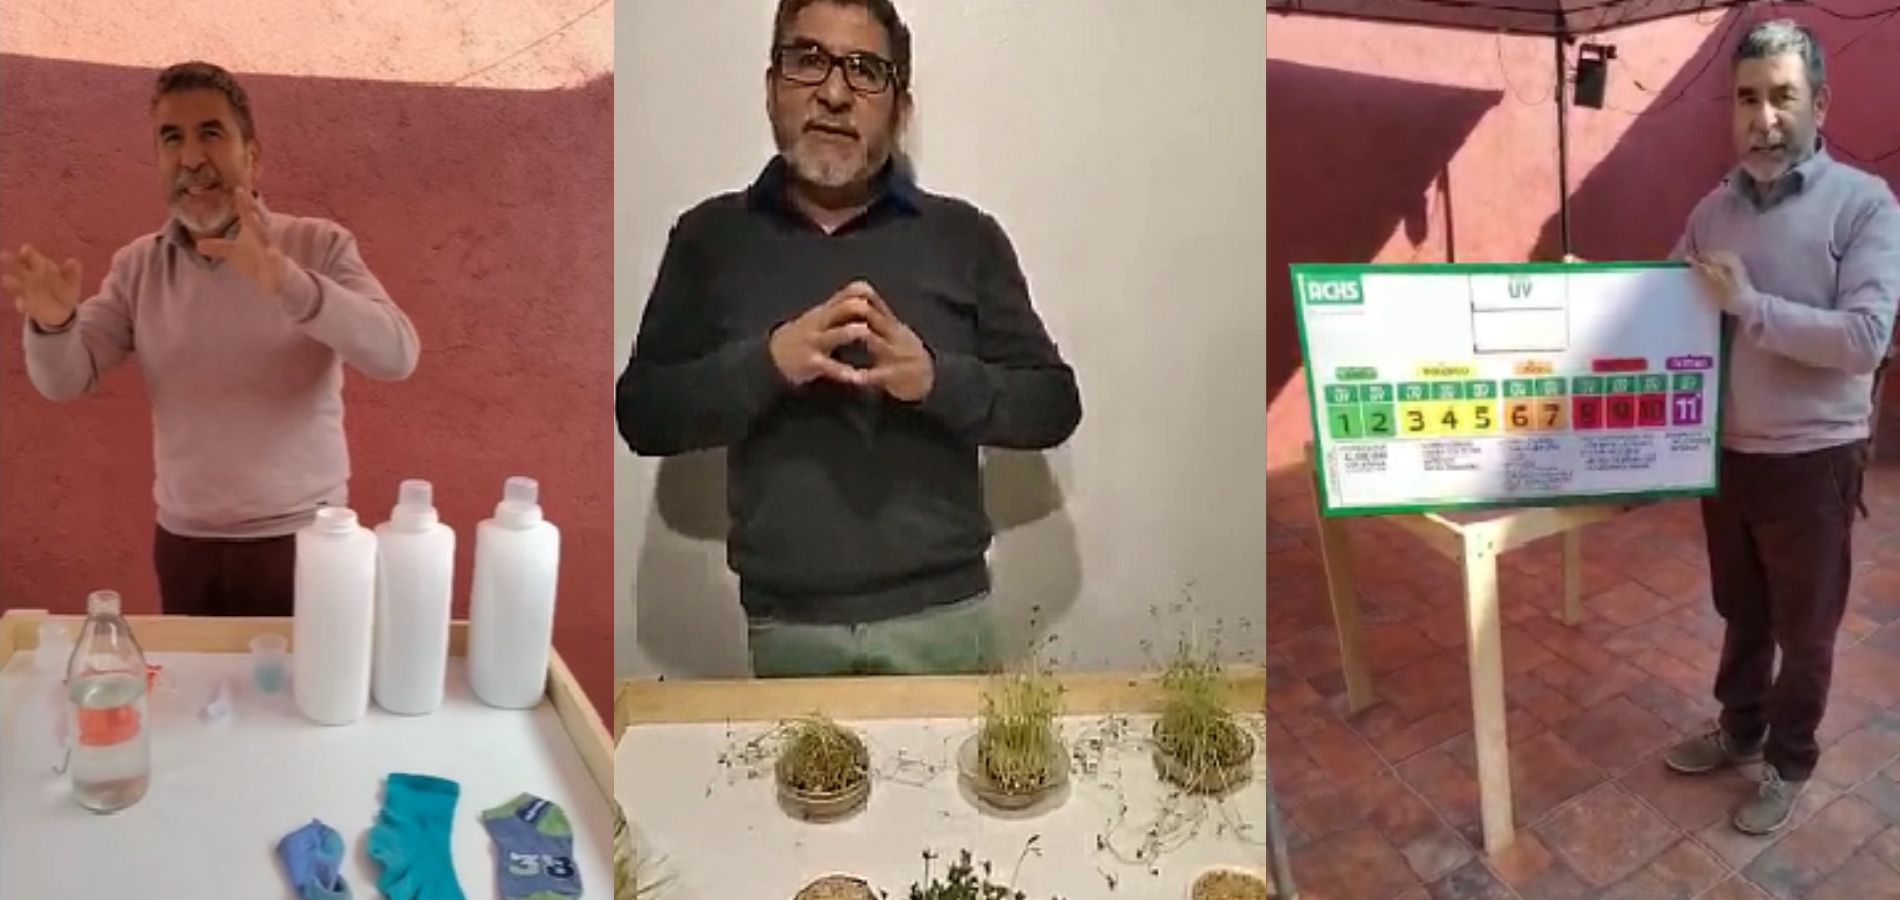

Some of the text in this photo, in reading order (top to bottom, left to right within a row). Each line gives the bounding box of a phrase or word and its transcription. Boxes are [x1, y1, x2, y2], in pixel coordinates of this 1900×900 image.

[1308, 280, 1359, 300] ACHS
[1508, 283, 1533, 299] UV
[1338, 413, 1350, 433] 1
[1371, 412, 1388, 432] 2
[1407, 410, 1425, 432] 3
[1441, 407, 1459, 430] 4
[1475, 406, 1491, 429] 5
[1511, 405, 1529, 427] 6
[1543, 403, 1560, 426] 7
